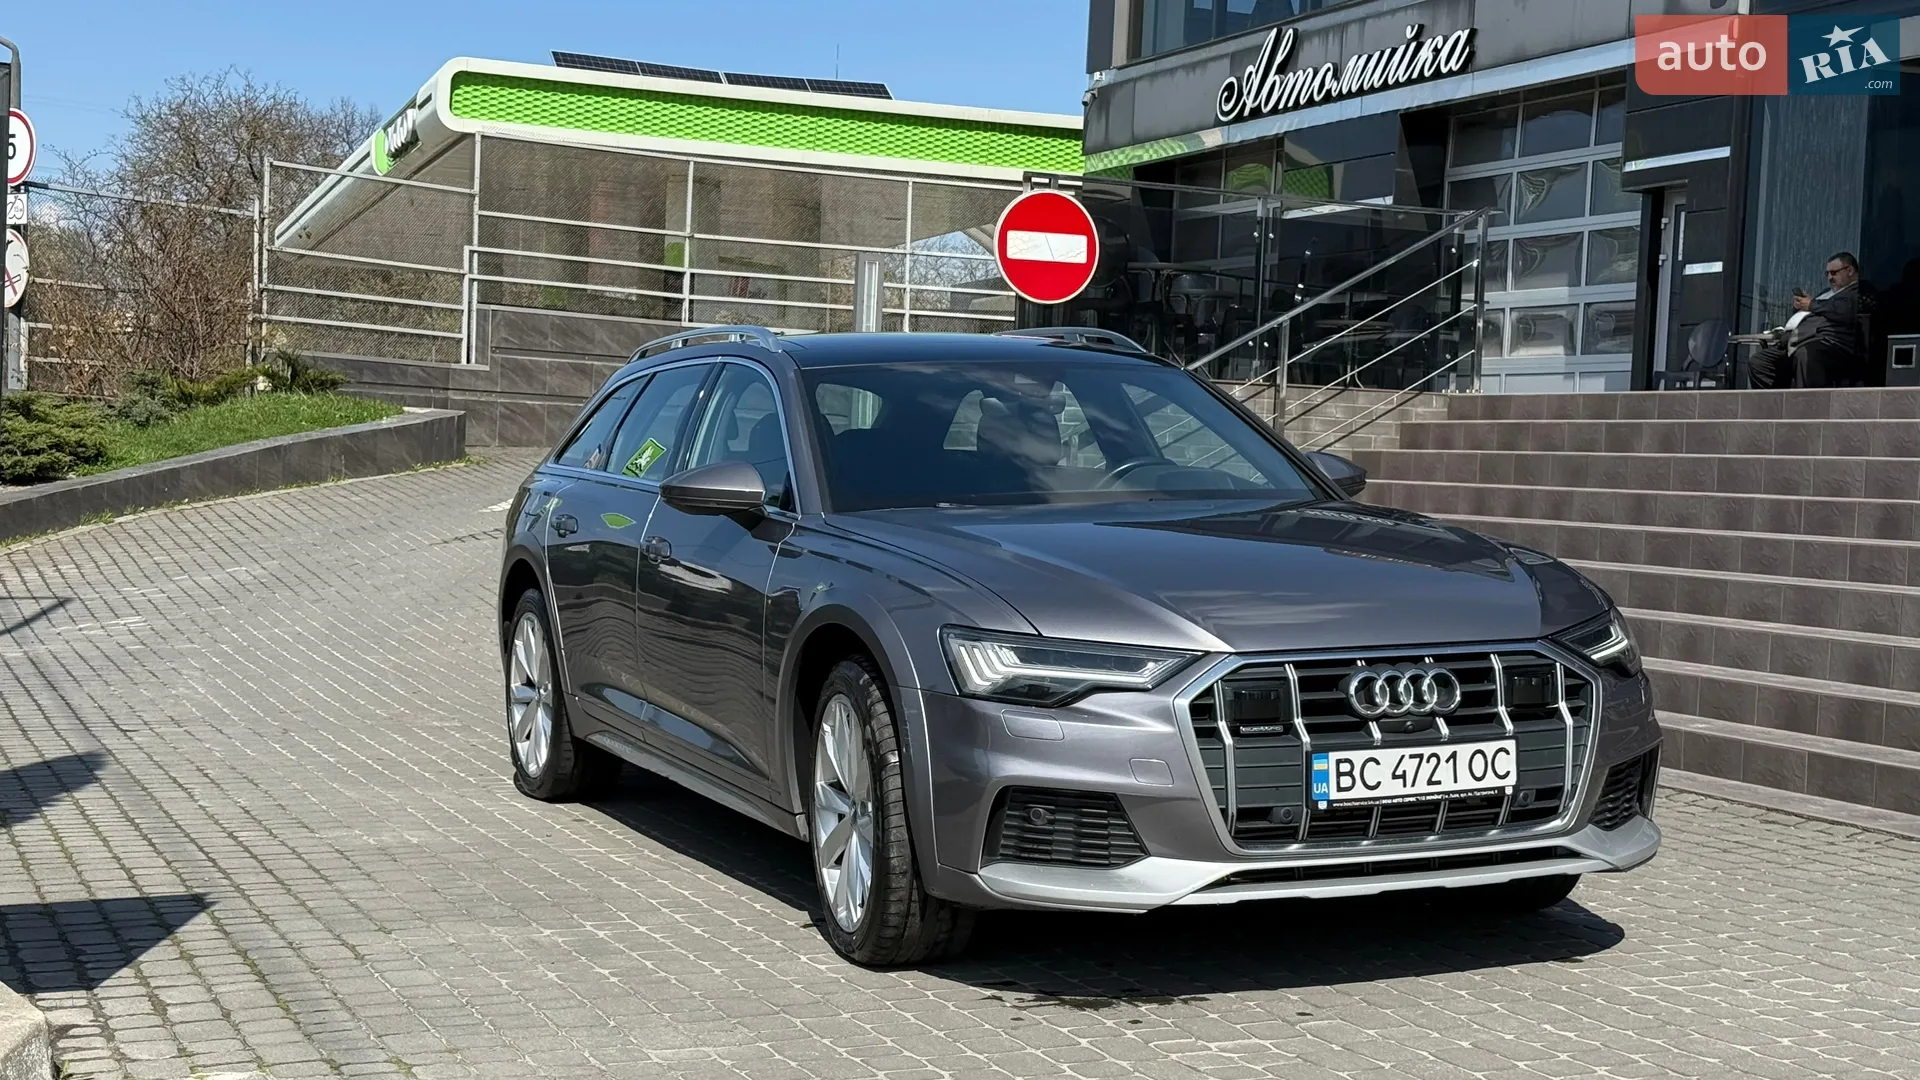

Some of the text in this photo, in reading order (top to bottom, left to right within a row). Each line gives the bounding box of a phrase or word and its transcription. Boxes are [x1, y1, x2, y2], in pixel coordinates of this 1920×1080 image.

[1216, 24, 1473, 122] Автомийка
[1313, 782, 1328, 794] UA
[1335, 747, 1511, 793] BC 4721 OC
